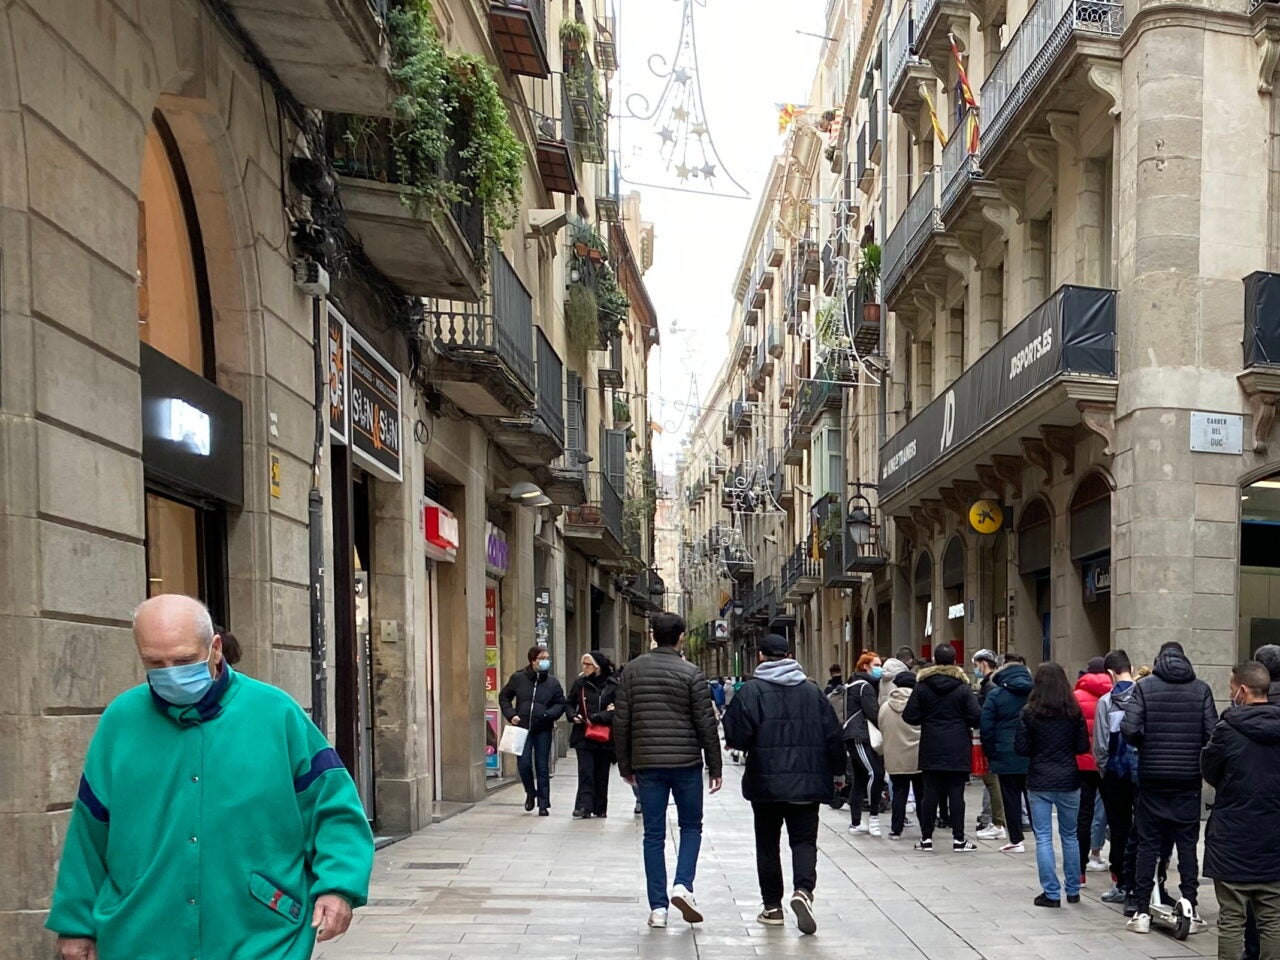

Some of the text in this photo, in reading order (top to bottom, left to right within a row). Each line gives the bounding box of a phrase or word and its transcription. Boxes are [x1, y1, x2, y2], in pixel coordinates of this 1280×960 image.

[1206, 417, 1227, 425] CARRER
[1211, 427, 1221, 435] DEL
[1210, 438, 1223, 447] DUC
